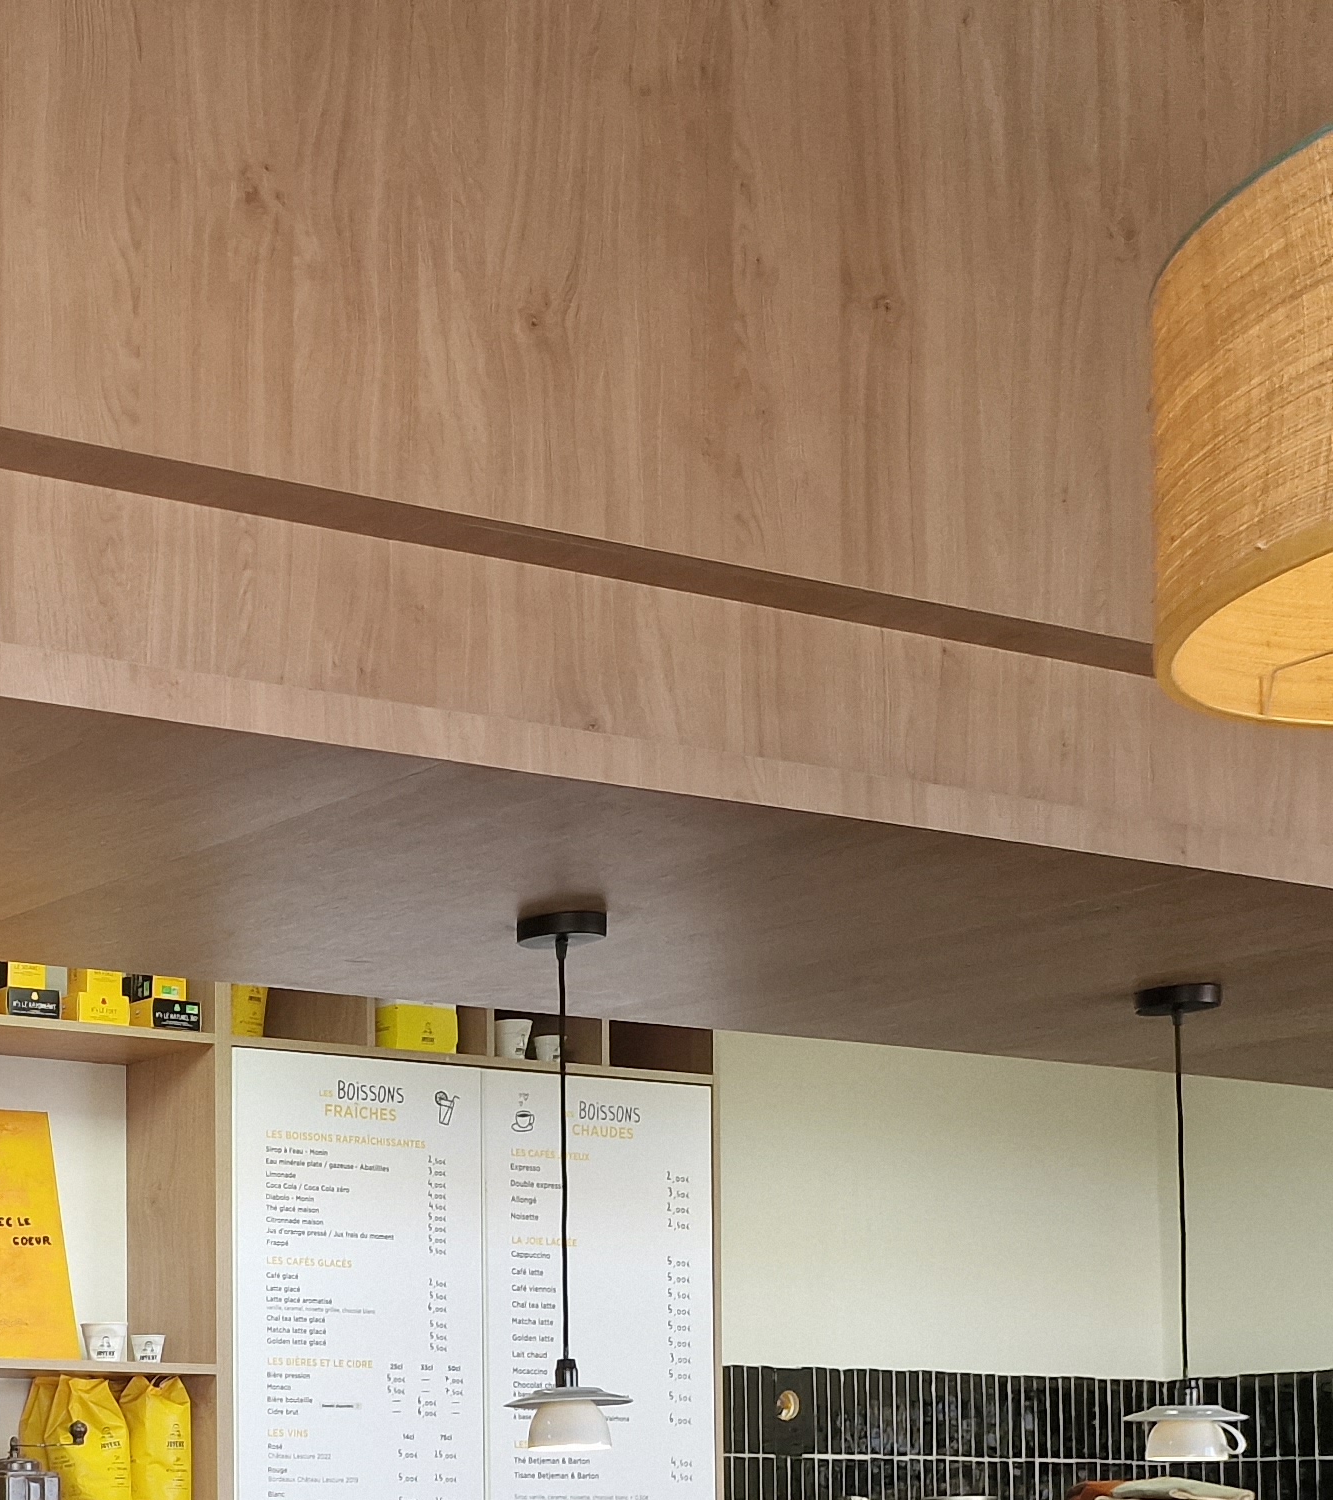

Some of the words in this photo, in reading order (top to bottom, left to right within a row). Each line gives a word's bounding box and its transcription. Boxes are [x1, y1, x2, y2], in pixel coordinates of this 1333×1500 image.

[338, 1080, 404, 1103] BOISSONS
[325, 1102, 396, 1121] FRAÎCHES
[579, 1101, 640, 1123] BOISSONS
[266, 1130, 283, 1140] LES
[286, 1131, 333, 1143] BOISSONS
[572, 1123, 633, 1139] CHAUDES
[17, 1217, 31, 1226] LE
[13, 1236, 51, 1246] COEUR
